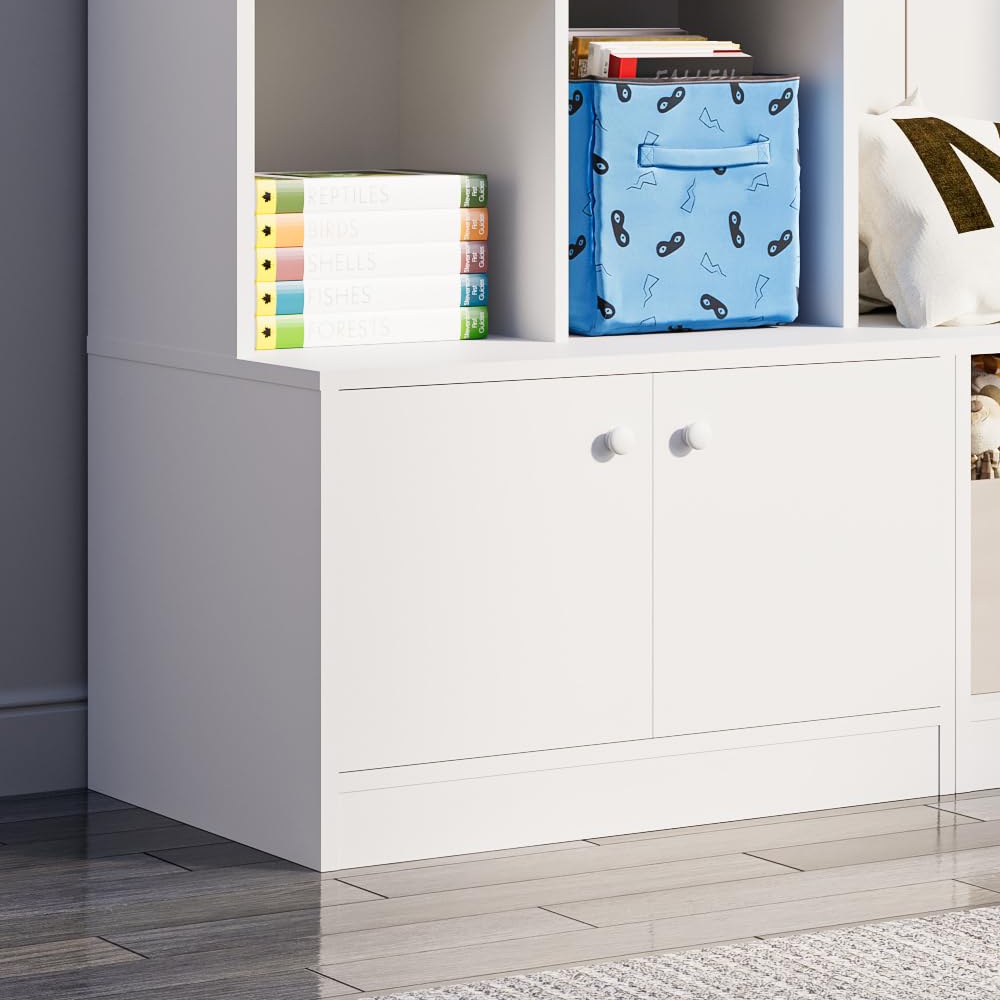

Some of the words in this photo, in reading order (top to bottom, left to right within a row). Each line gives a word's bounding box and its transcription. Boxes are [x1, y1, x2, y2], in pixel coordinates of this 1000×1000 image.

[307, 184, 391, 206] REPTILES
[307, 217, 361, 240] BIRDS
[307, 251, 377, 273] SHELLS
[307, 284, 372, 306] FISHES
[307, 317, 392, 340] FORESTS
